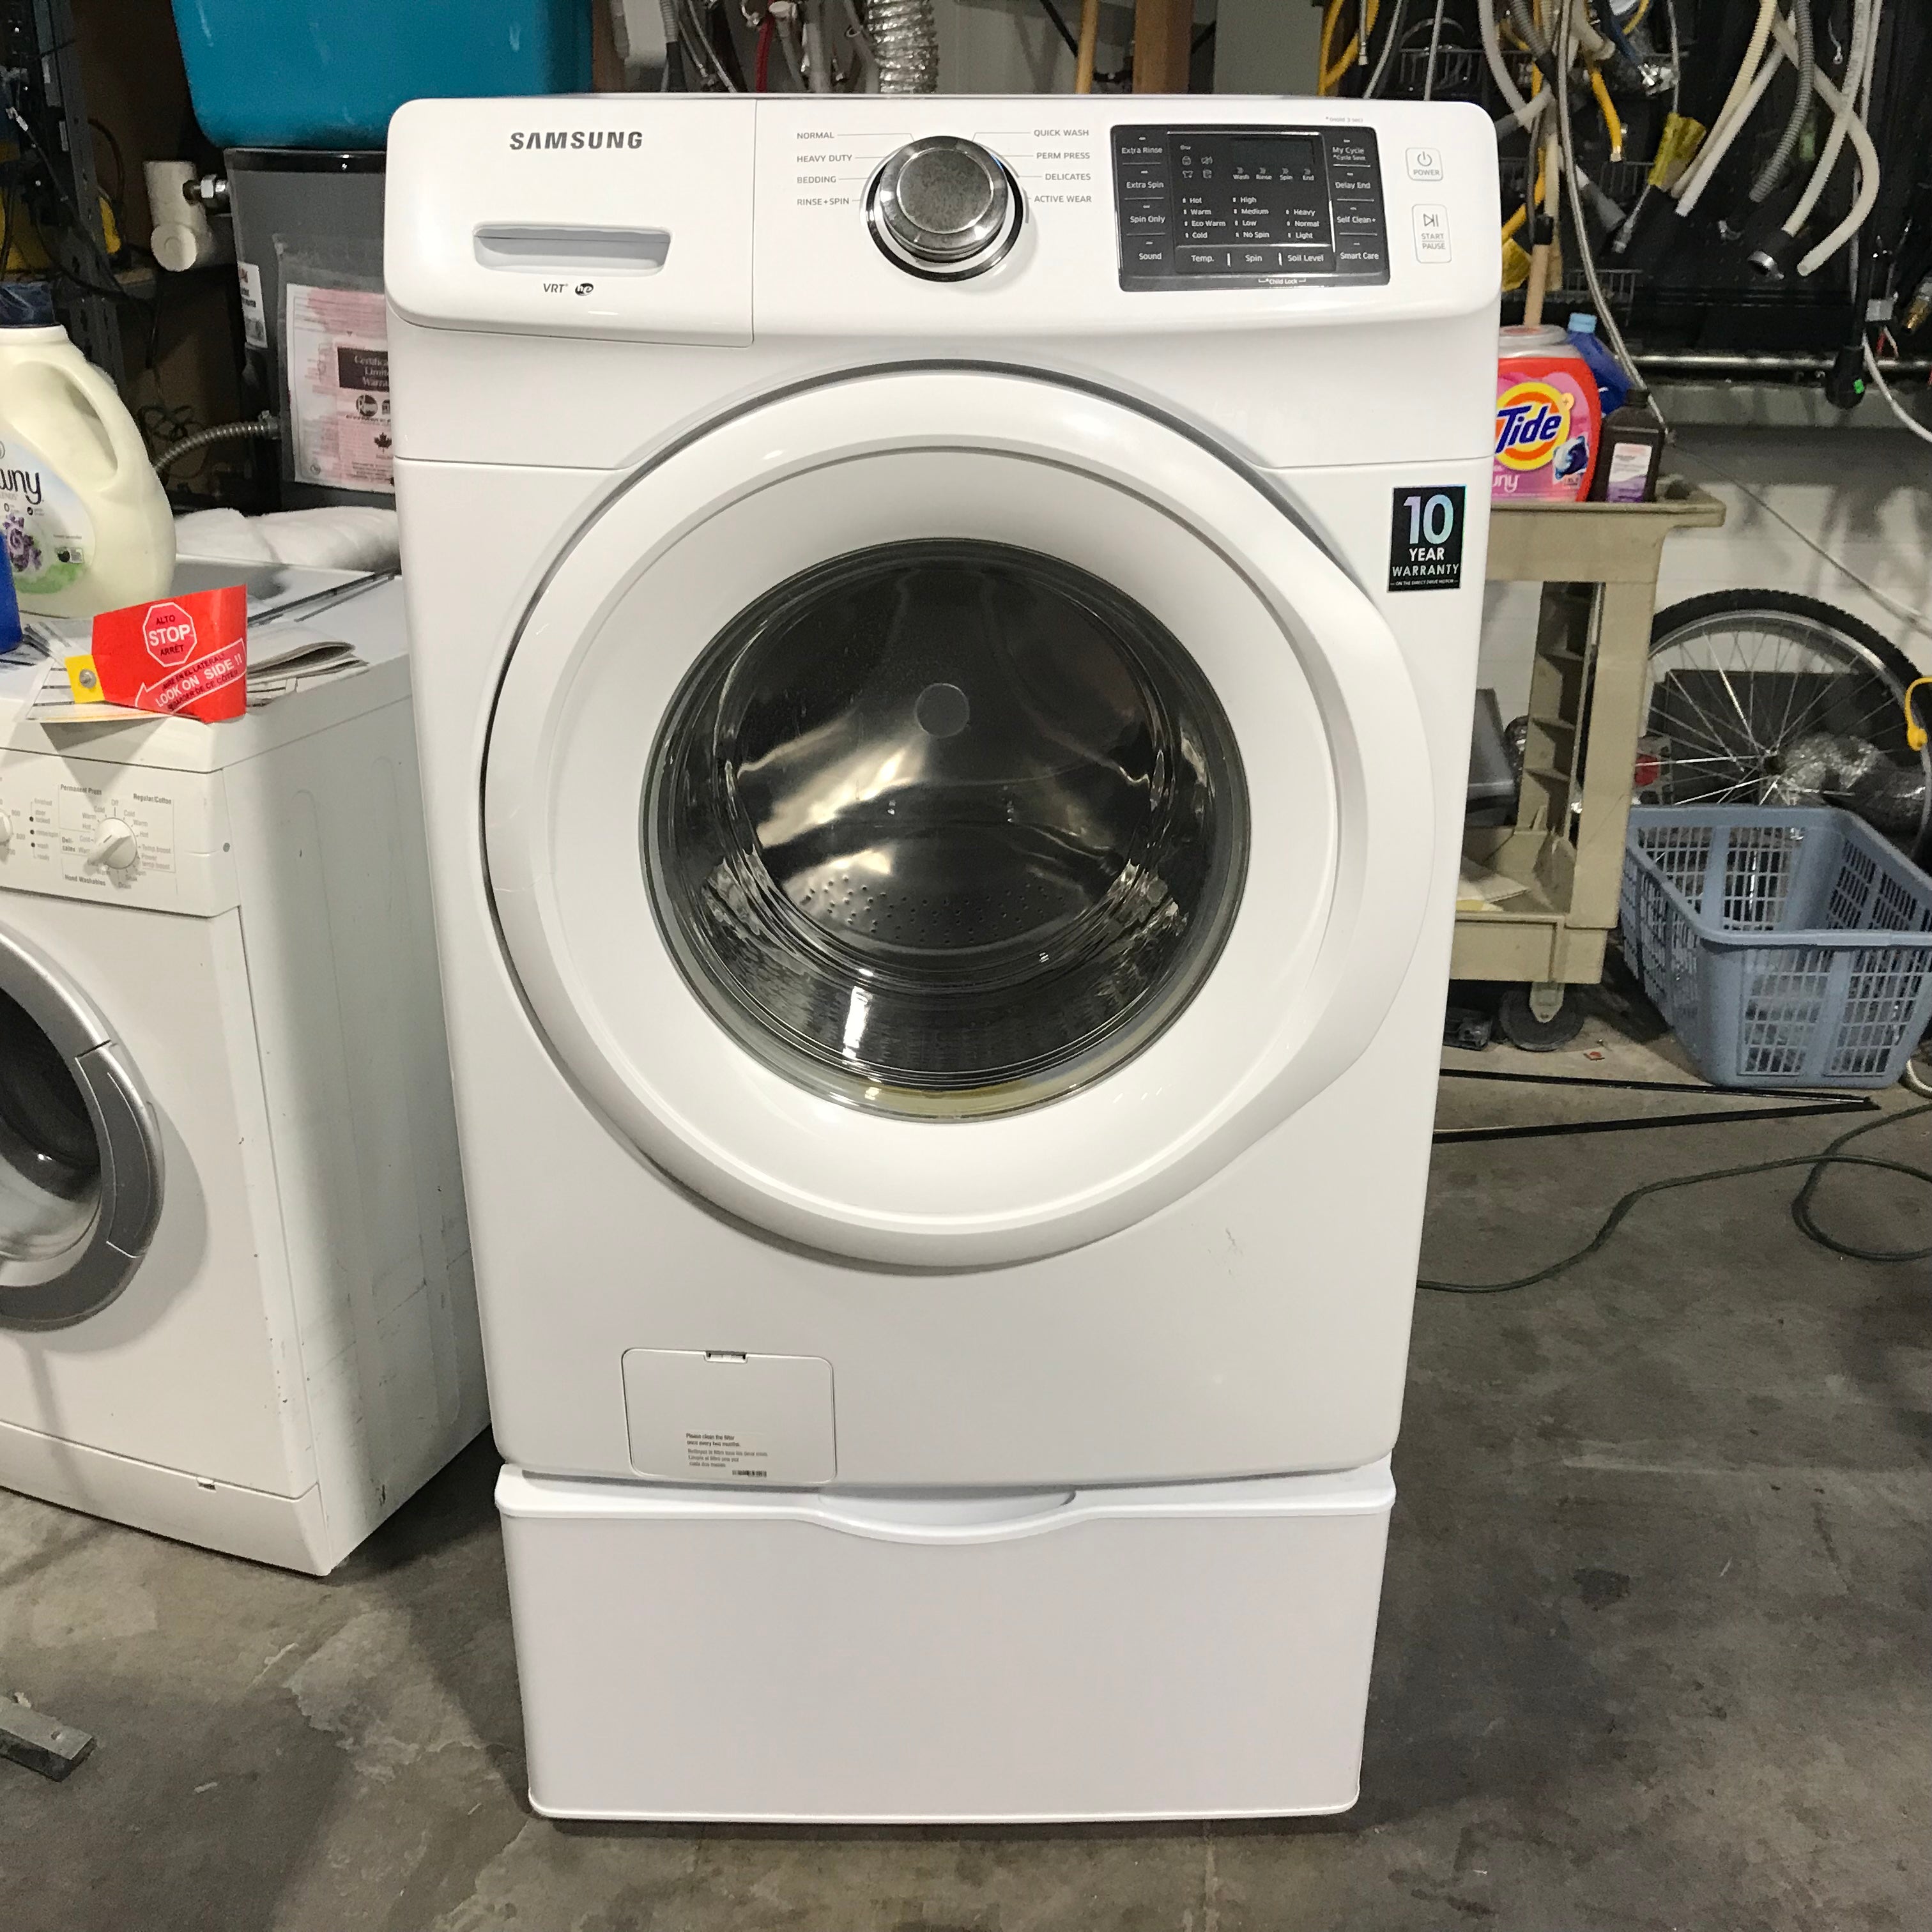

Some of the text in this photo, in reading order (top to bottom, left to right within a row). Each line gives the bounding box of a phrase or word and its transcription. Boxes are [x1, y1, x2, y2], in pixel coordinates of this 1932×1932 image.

[797, 132, 834, 140] NORMAL
[1034, 128, 1090, 137] QUICK WASH
[509, 132, 643, 150] SAMSUNG
[1036, 151, 1061, 160] PERM
[1121, 147, 1141, 155] Extra
[797, 154, 852, 163] HEAVY DUTY
[797, 176, 836, 184] BEDDING
[1045, 172, 1091, 181] DELICATES
[1147, 181, 1164, 190] Spin
[797, 197, 850, 206] RINSE+SPIN
[1034, 194, 1092, 203] ACTIVE WEAR
[1293, 208, 1315, 217] Heavy
[1130, 215, 1165, 224] Spin Only
[1254, 231, 1270, 239] Spin
[1138, 252, 1162, 261] Sound
[1191, 254, 1215, 263] Temp.
[1245, 254, 1262, 263] Spin
[1340, 252, 1379, 260] Smart Care
[1495, 404, 1562, 454] Tide
[1403, 494, 1454, 544] 10
[1409, 547, 1445, 562] YEAR
[1392, 563, 1459, 577] WARRANTY
[156, 615, 176, 625] ALTO
[148, 624, 191, 647] STOP
[155, 684, 182, 708] LOOK
[182, 675, 200, 691] ON
[204, 659, 234, 680] SIDE
[61, 784, 88, 793] Permanent
